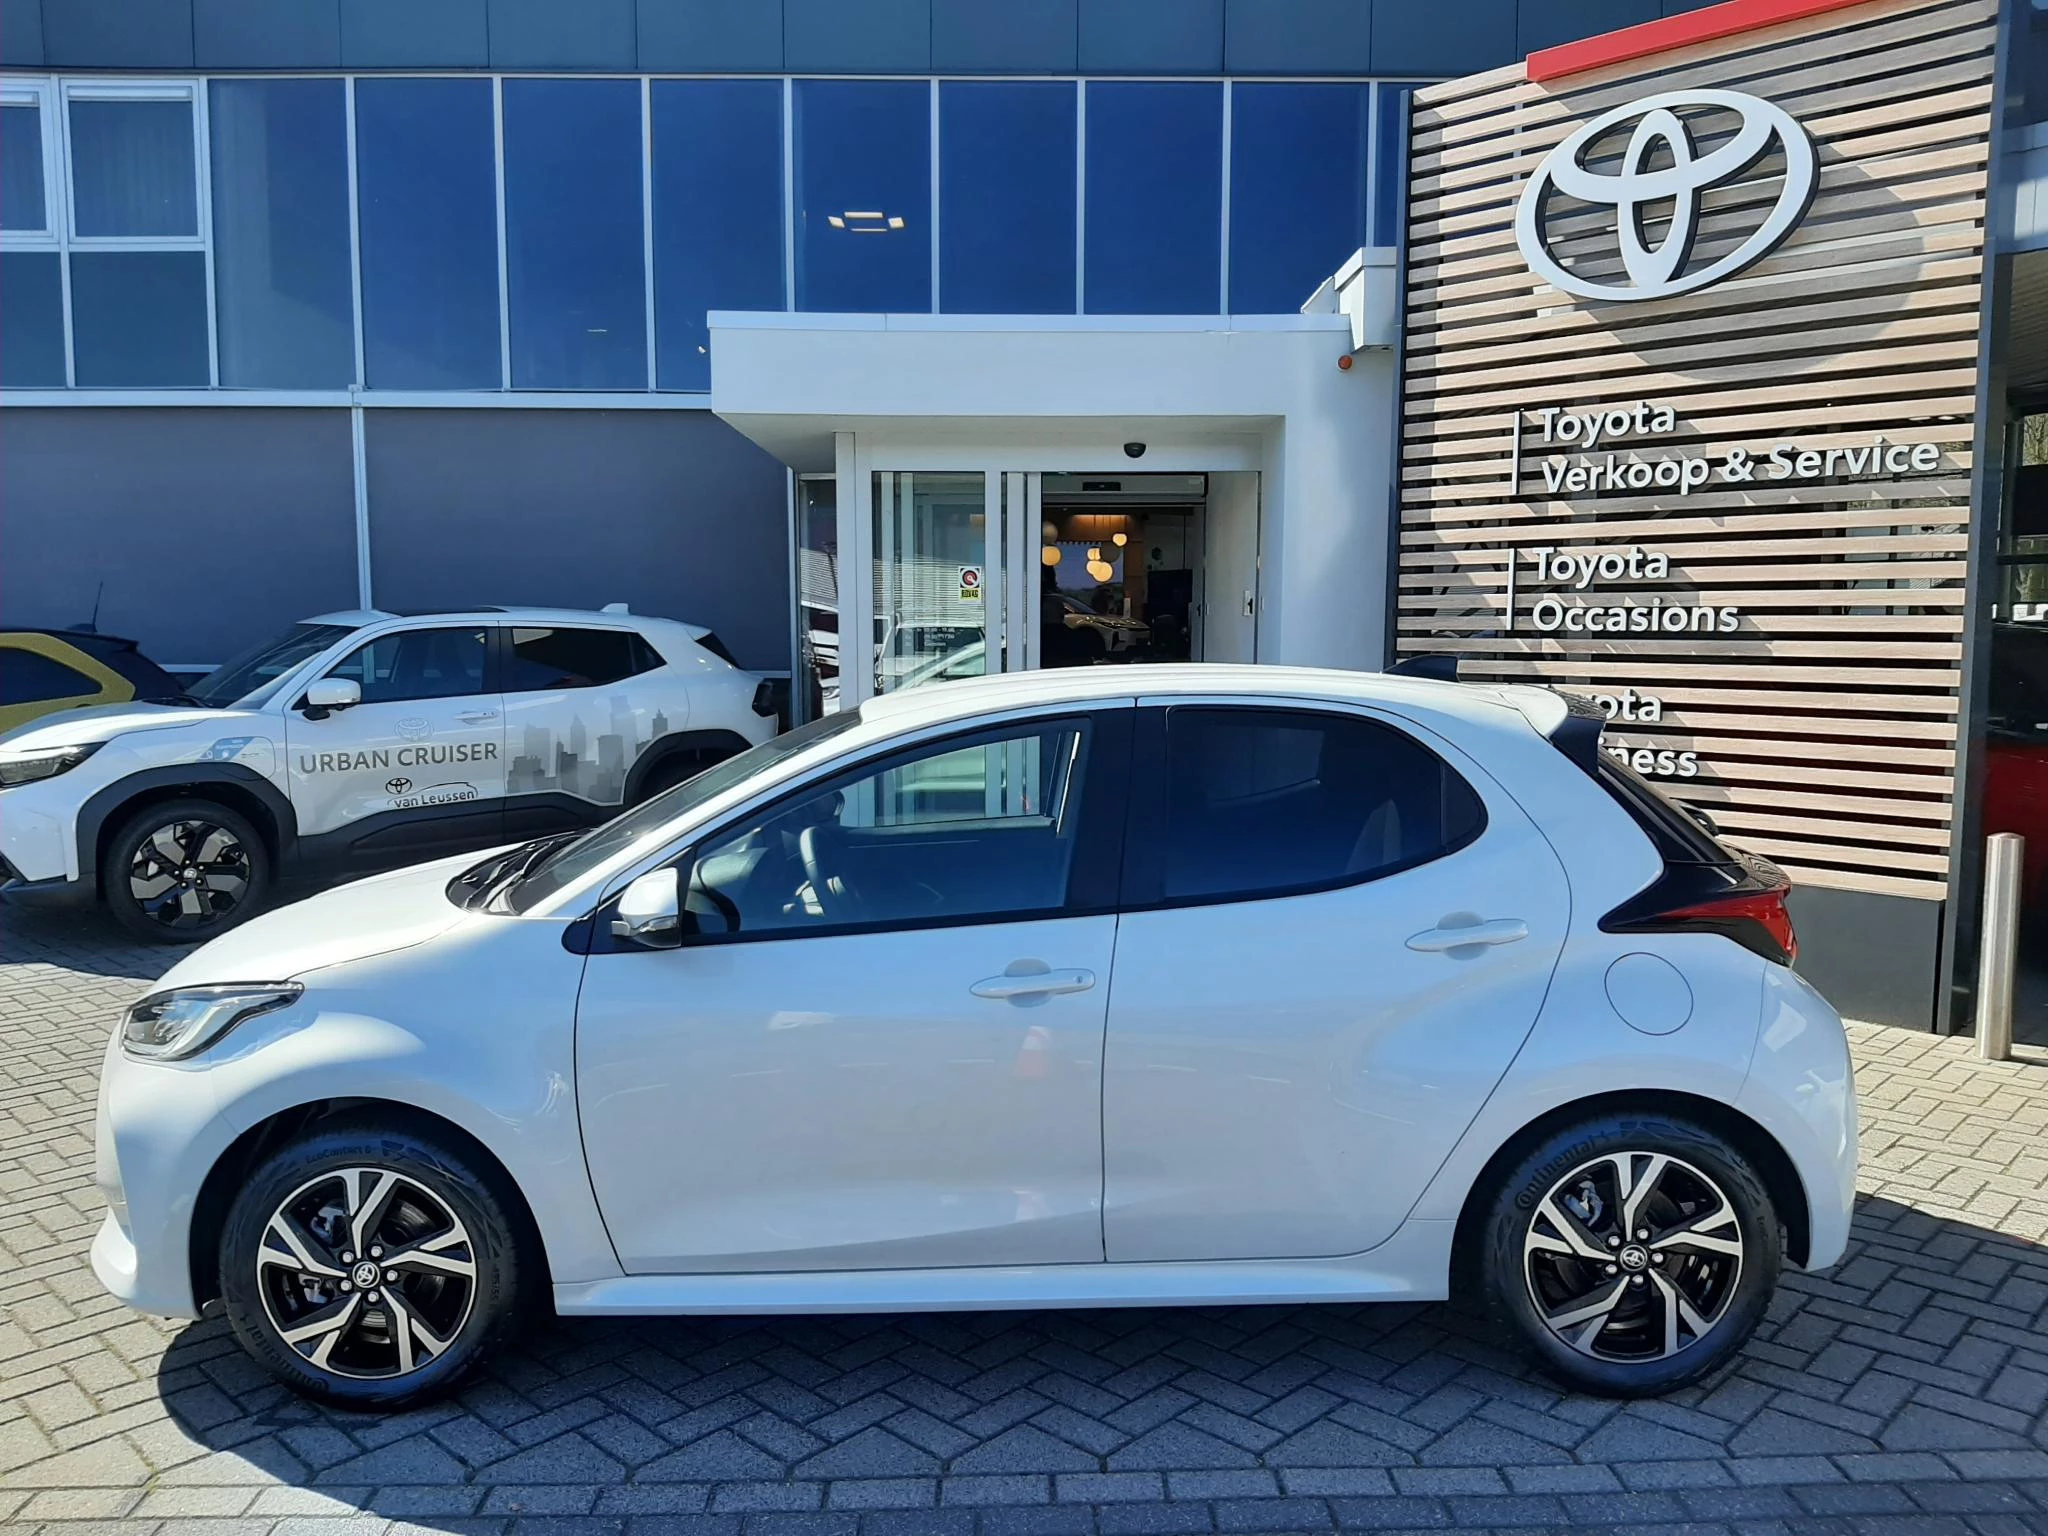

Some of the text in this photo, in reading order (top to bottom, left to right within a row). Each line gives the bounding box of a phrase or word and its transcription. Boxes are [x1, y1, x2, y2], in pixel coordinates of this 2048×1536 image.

[1538, 402, 1676, 448] Toyota
[1541, 436, 1940, 495] Verkoop & Service
[1533, 547, 1669, 589] Toyota
[1532, 597, 1739, 632] Occasions
[1594, 689, 1661, 722] ota
[300, 743, 498, 774] URBAN CRUISER
[1598, 737, 1698, 777] ness
[394, 791, 474, 808] van Leussen
